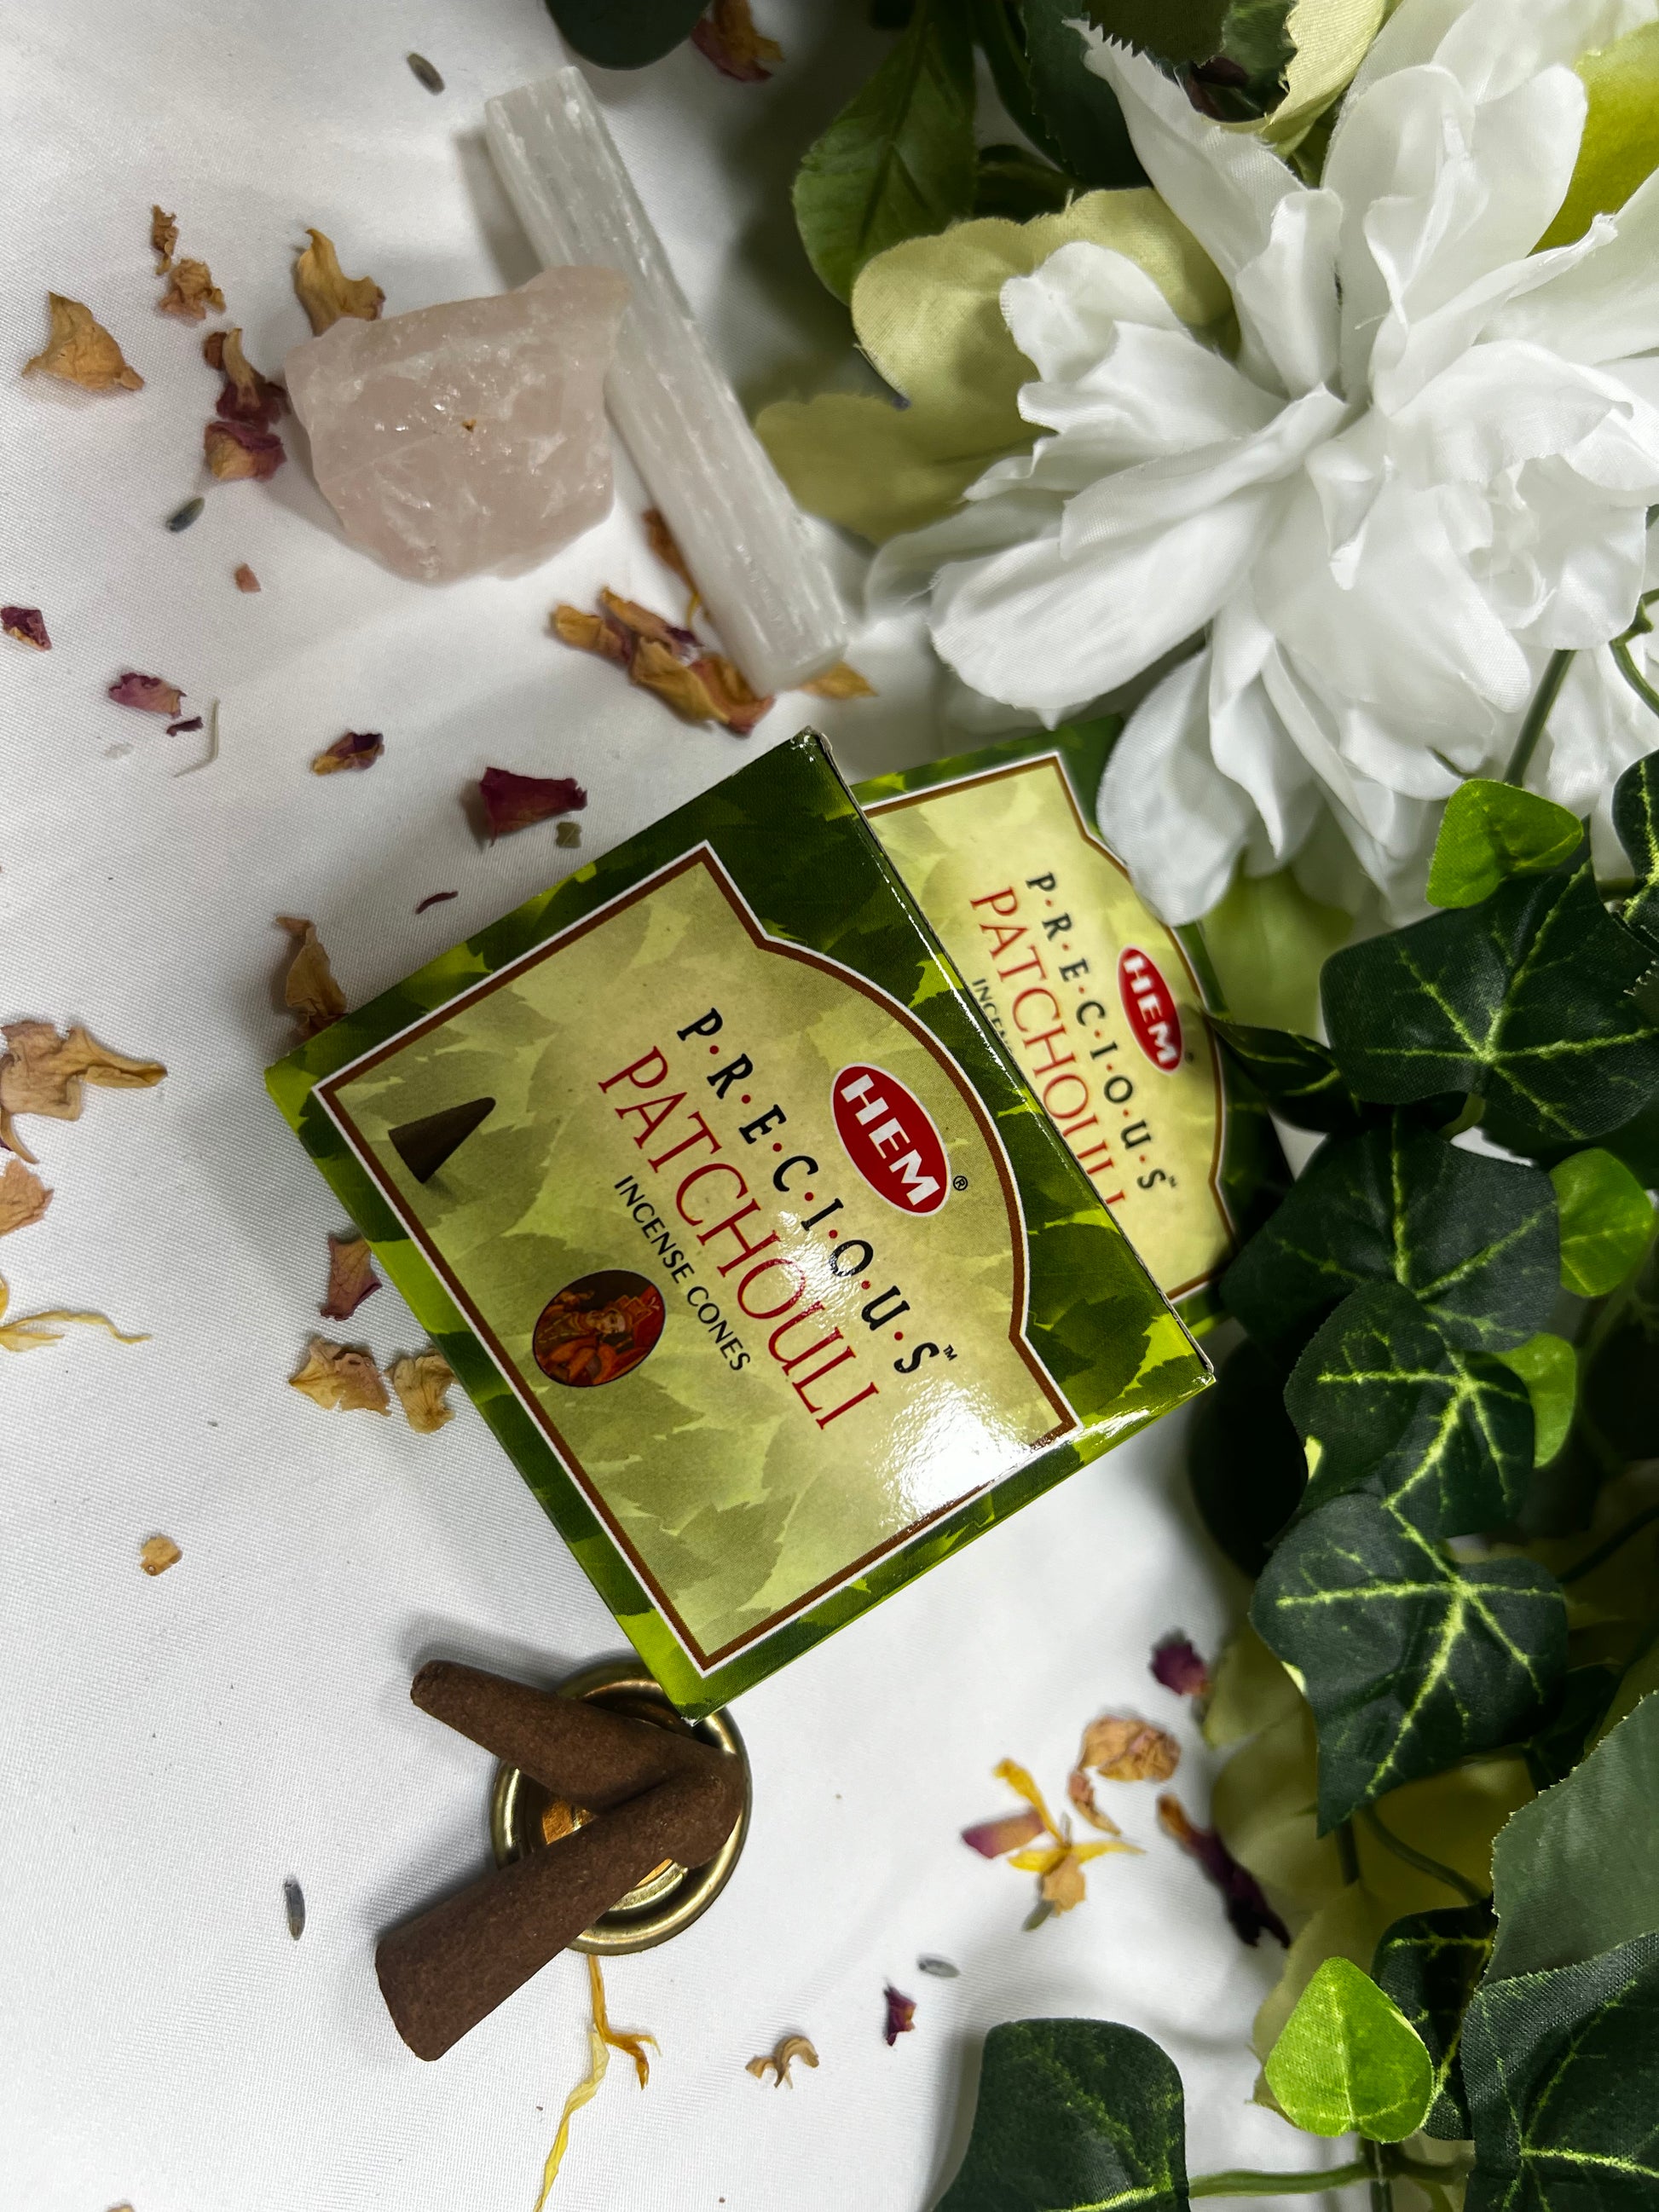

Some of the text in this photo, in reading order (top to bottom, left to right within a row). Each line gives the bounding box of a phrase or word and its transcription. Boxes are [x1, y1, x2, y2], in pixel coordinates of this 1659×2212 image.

[1123, 955, 1177, 1063] HEM
[841, 1074, 940, 1206] HEM
[598, 1046, 879, 1429] PATCHOULI
[614, 1175, 751, 1372] INCENSE CONES
